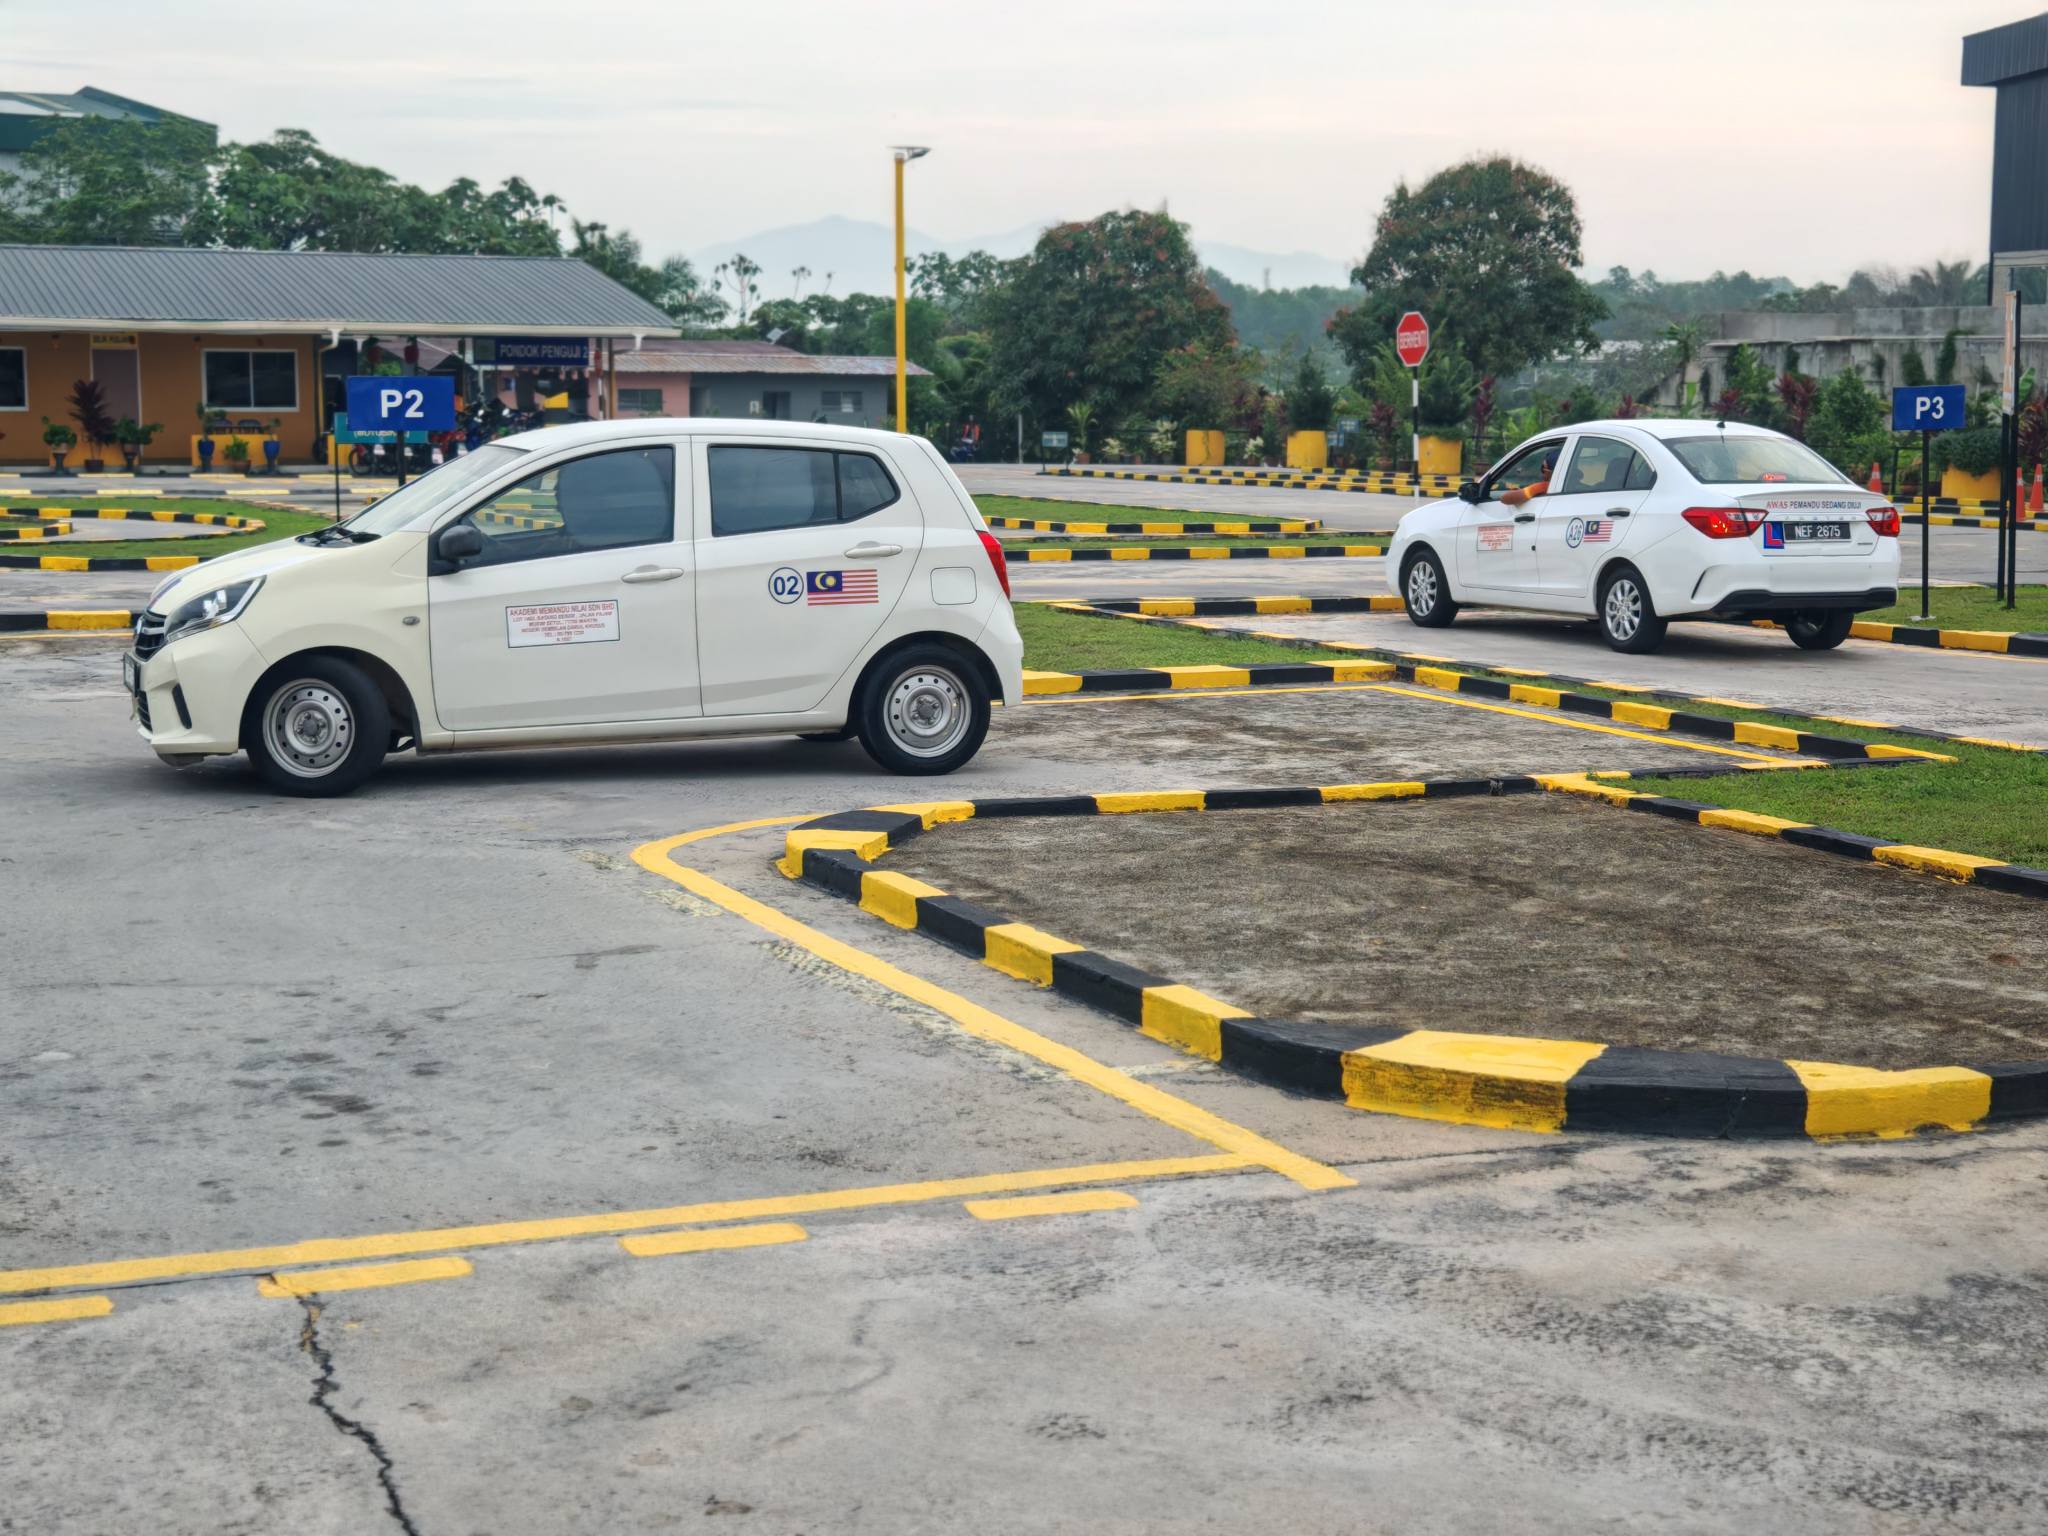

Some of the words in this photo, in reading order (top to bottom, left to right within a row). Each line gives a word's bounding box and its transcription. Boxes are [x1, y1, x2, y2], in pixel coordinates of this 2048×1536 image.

[500, 344, 540, 358] PONDOK
[541, 345, 581, 359] PENGUJI
[582, 346, 589, 359] 2
[381, 389, 424, 418] P2
[1915, 396, 1944, 420] P3
[1766, 501, 1788, 509] AWAS
[1790, 501, 1820, 509] PEMANDU
[1821, 501, 1846, 509] SEDANG
[1794, 525, 1813, 537] NEF
[1816, 525, 1841, 537] 2675
[773, 575, 800, 596] 02
[510, 607, 539, 616] AKADEMI
[539, 605, 570, 615] MEMANDU
[571, 604, 587, 613] NILAI
[588, 603, 601, 612] SDN
